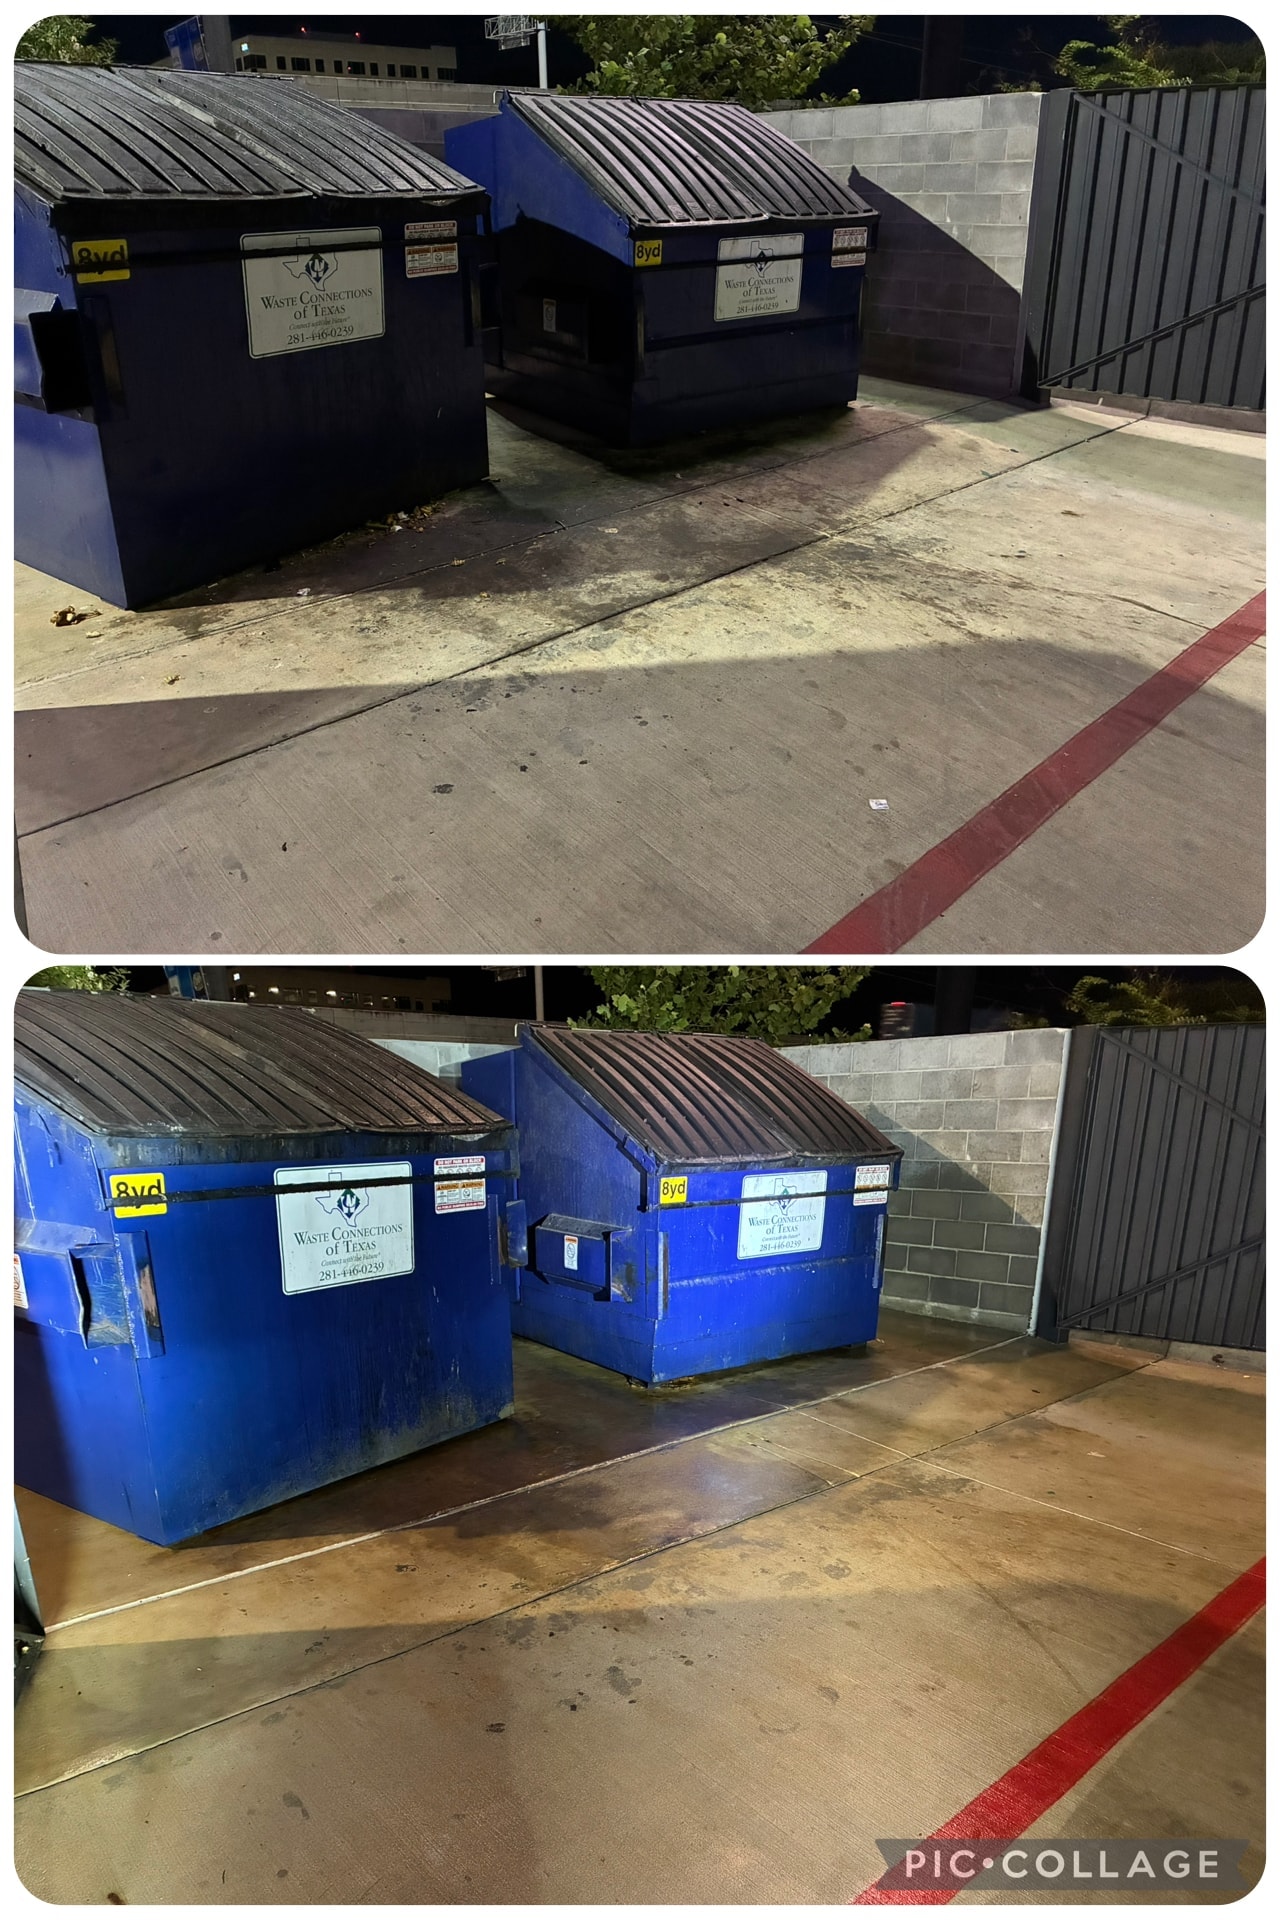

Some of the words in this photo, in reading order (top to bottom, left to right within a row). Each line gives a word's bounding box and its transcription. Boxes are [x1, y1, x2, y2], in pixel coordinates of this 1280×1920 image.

[637, 244, 660, 262] 8yd
[725, 280, 746, 289] WASTE
[748, 276, 794, 287] CONNECTIONS
[260, 295, 297, 310] WASTE
[300, 288, 373, 305] CONNECTIONS
[743, 288, 752, 297] of
[754, 286, 775, 296] TEXAS
[294, 305, 307, 320] of
[311, 304, 346, 317] TEXAS
[287, 325, 354, 345] 281-446-0239
[662, 1180, 685, 1198] 8yd
[748, 1216, 770, 1227] WASTE
[771, 1214, 817, 1225] CONNECTIONS
[766, 1225, 775, 1235] of
[777, 1223, 798, 1233] TEXAS
[294, 1231, 329, 1246] WASTE
[331, 1224, 403, 1241] CONNECTIONS
[326, 1241, 339, 1256] of
[343, 1240, 376, 1253] TEXAS
[319, 1261, 384, 1281] 281-446-0239
